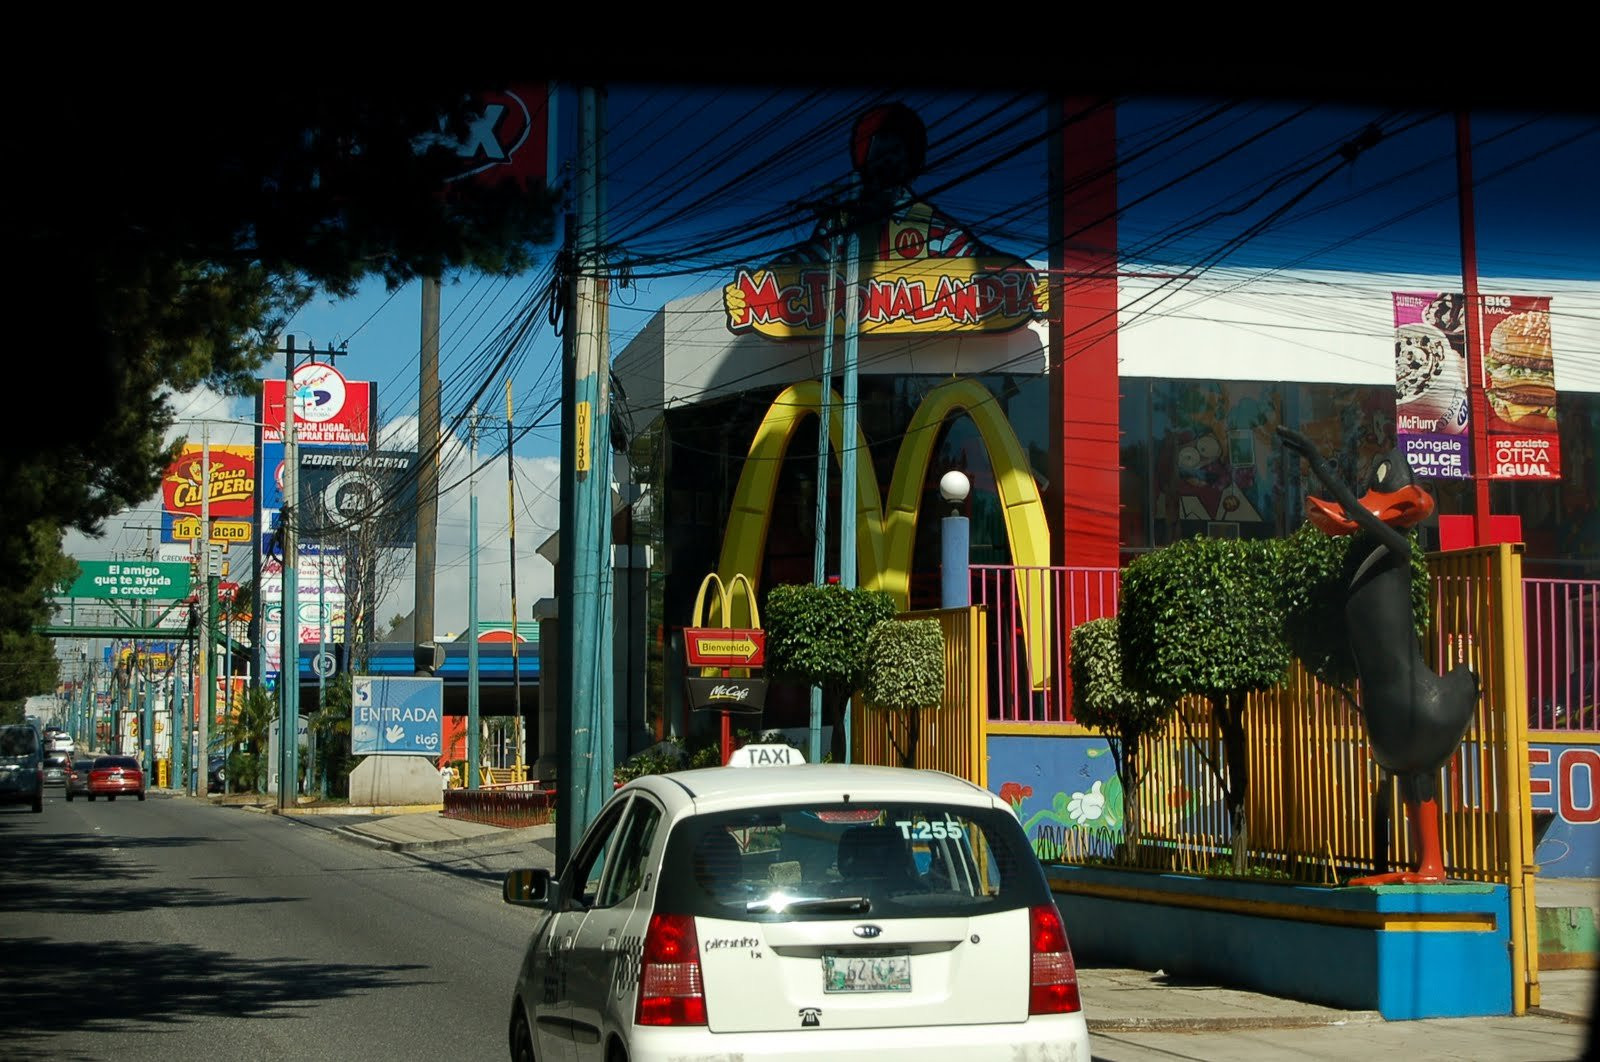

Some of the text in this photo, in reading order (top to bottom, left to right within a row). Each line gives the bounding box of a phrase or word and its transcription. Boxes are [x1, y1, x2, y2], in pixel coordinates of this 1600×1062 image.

[1484, 296, 1511, 307] BIG
[1398, 415, 1438, 432] McFlurry
[294, 431, 323, 441] MPRAR
[324, 431, 335, 441] EN
[1407, 438, 1461, 452] póngale
[1407, 453, 1461, 466] DULCE
[1496, 449, 1550, 463] OTRA
[211, 469, 246, 482] POLLO
[1441, 466, 1461, 477] día
[1496, 463, 1550, 476] IGUAL
[179, 524, 244, 537] la cacao
[109, 565, 160, 578] El amigo
[94, 575, 171, 587] que te ayuda
[121, 587, 159, 595] crecer
[702, 643, 750, 652] Bienvenido
[360, 707, 438, 722] ENTRADA
[748, 748, 790, 765] TAXI
[895, 820, 962, 840] T.255
